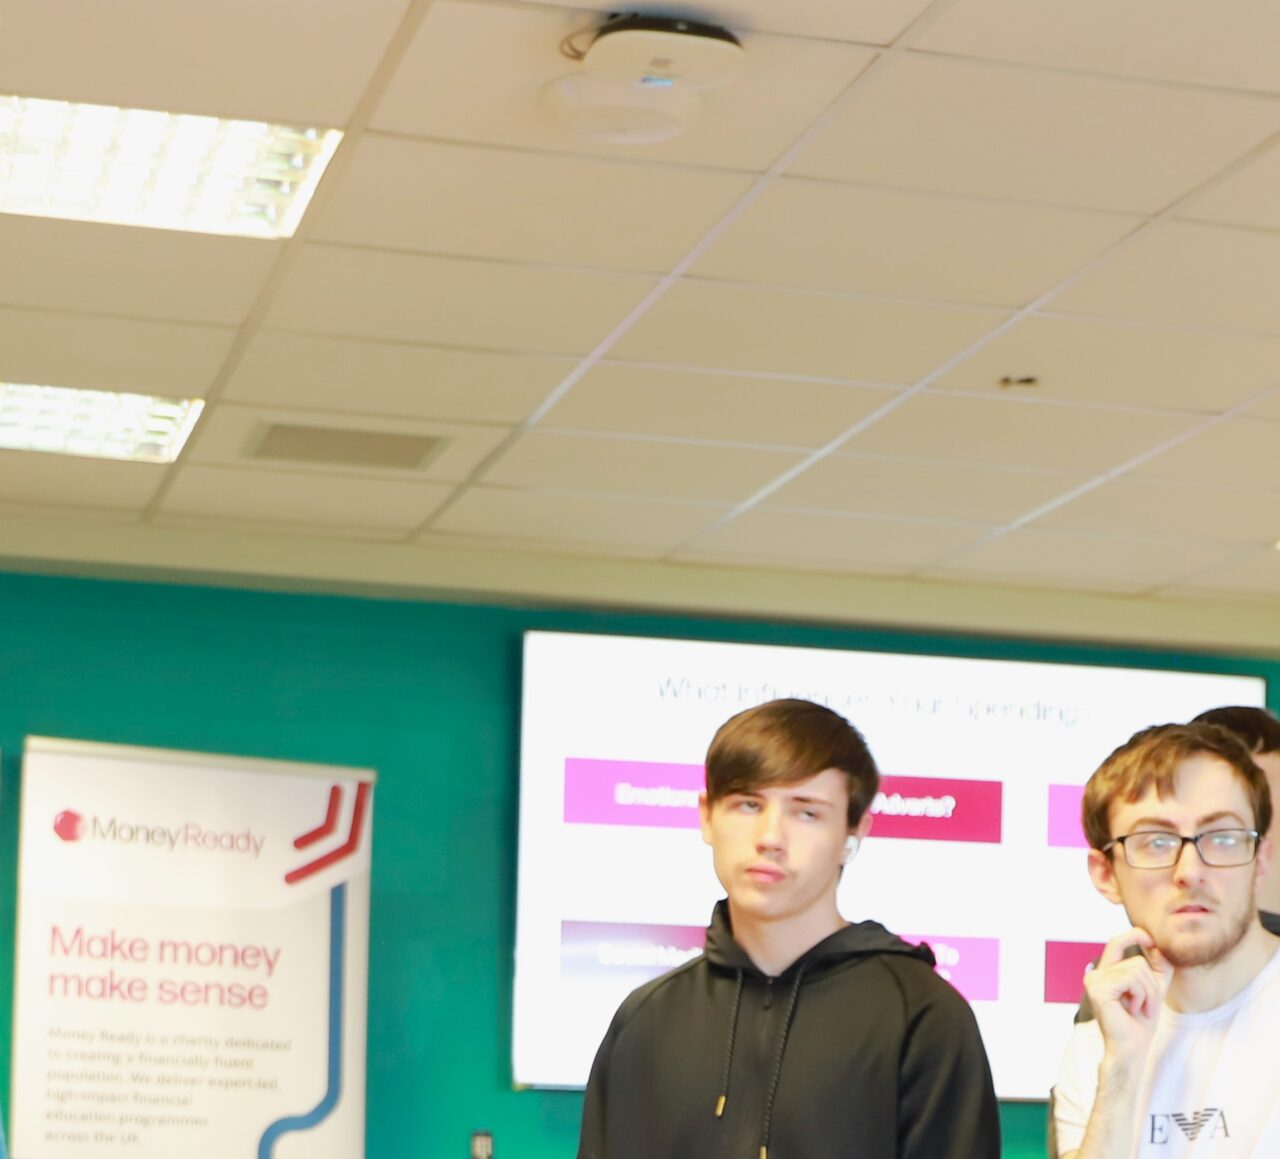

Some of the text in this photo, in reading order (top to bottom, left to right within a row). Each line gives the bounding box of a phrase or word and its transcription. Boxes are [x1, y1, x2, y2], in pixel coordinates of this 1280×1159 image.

[656, 676, 727, 702] What
[50, 923, 282, 978] Make money
[48, 968, 270, 1010] make sense
